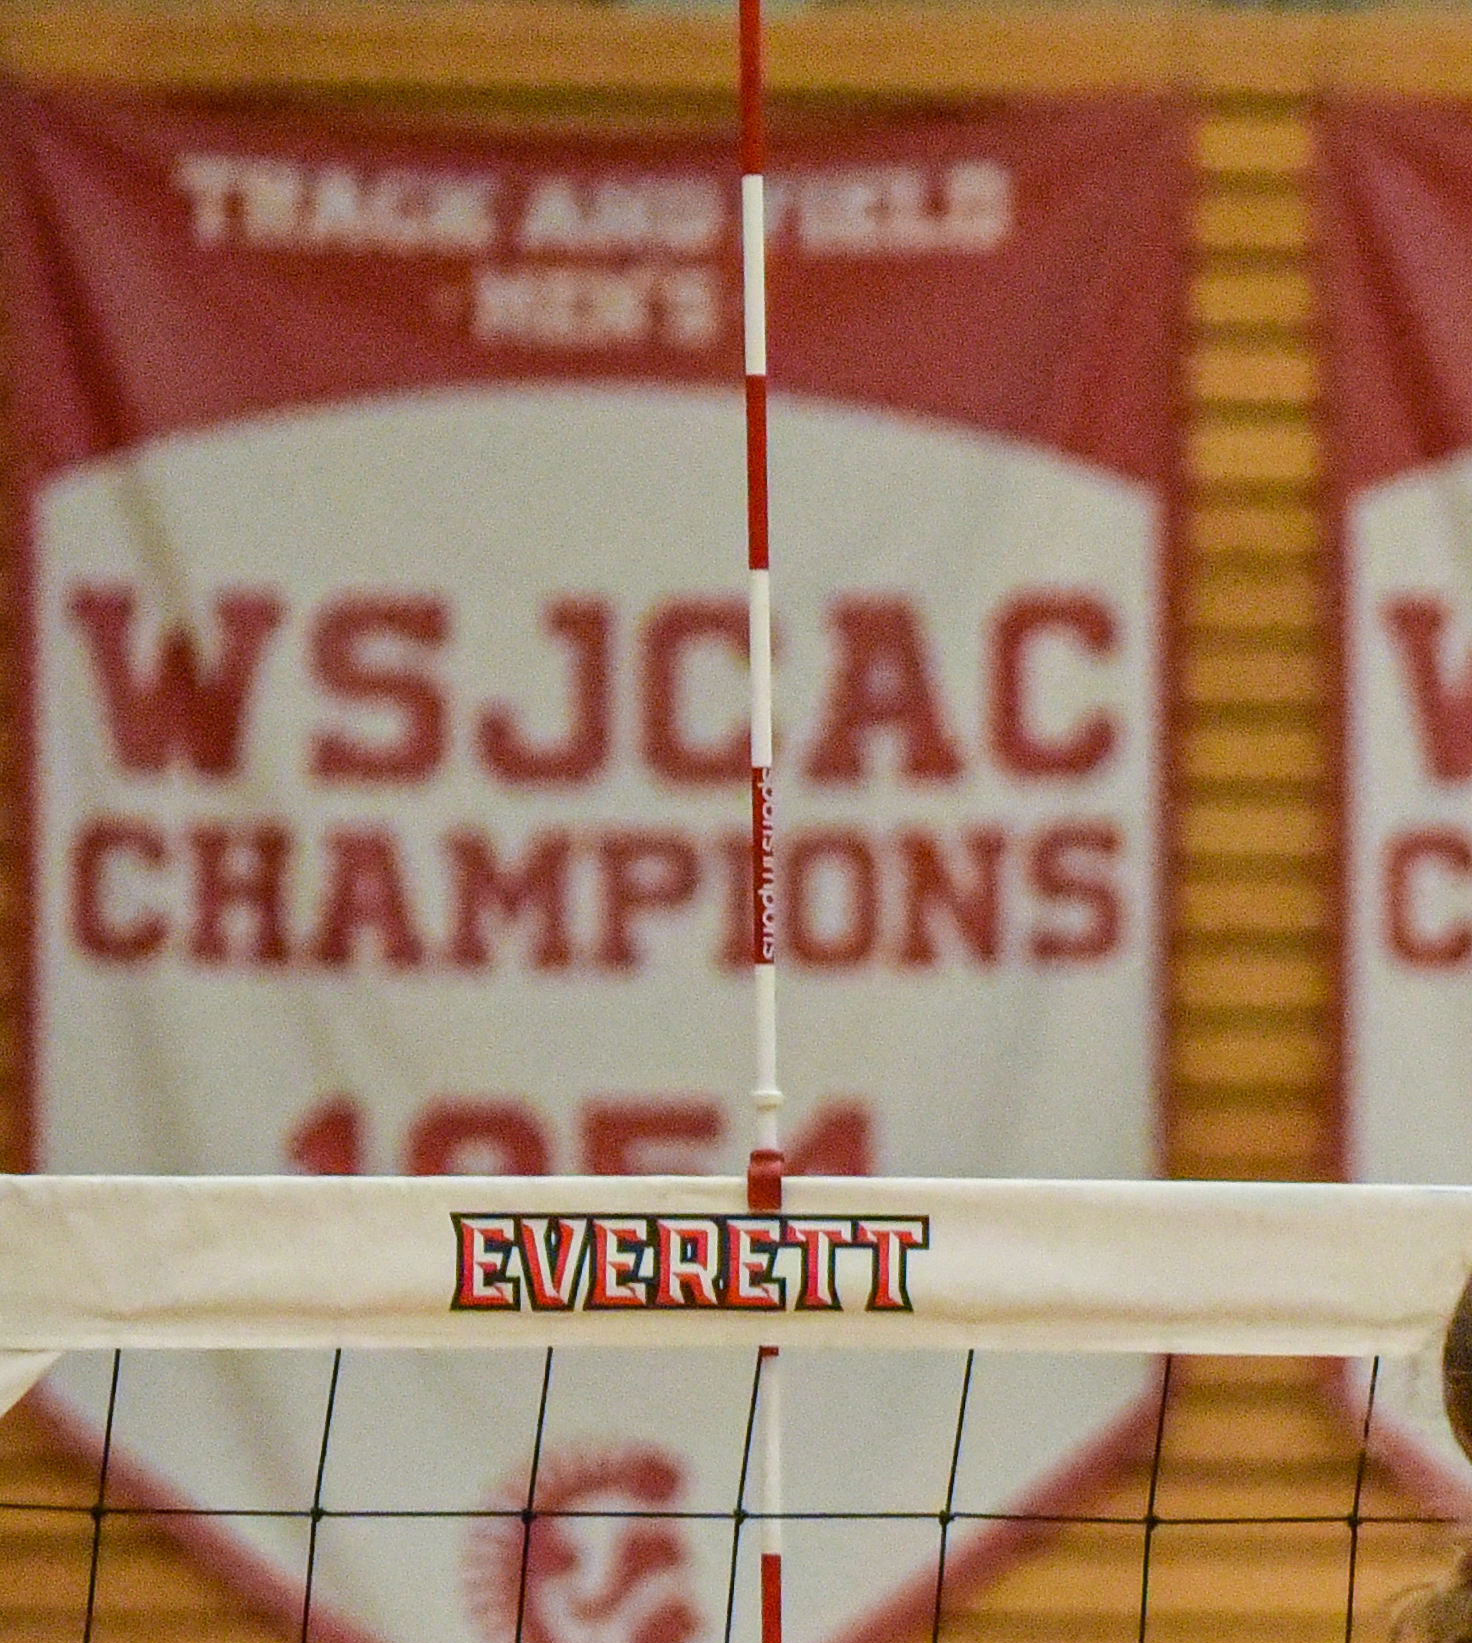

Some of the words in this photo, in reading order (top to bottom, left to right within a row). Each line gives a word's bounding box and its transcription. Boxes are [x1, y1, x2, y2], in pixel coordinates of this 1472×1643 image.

[519, 176, 721, 250] AND
[67, 588, 1120, 785] WSJCAC
[71, 817, 1122, 970] CHAMPIONS
[450, 1212, 929, 1312] EVERETT
